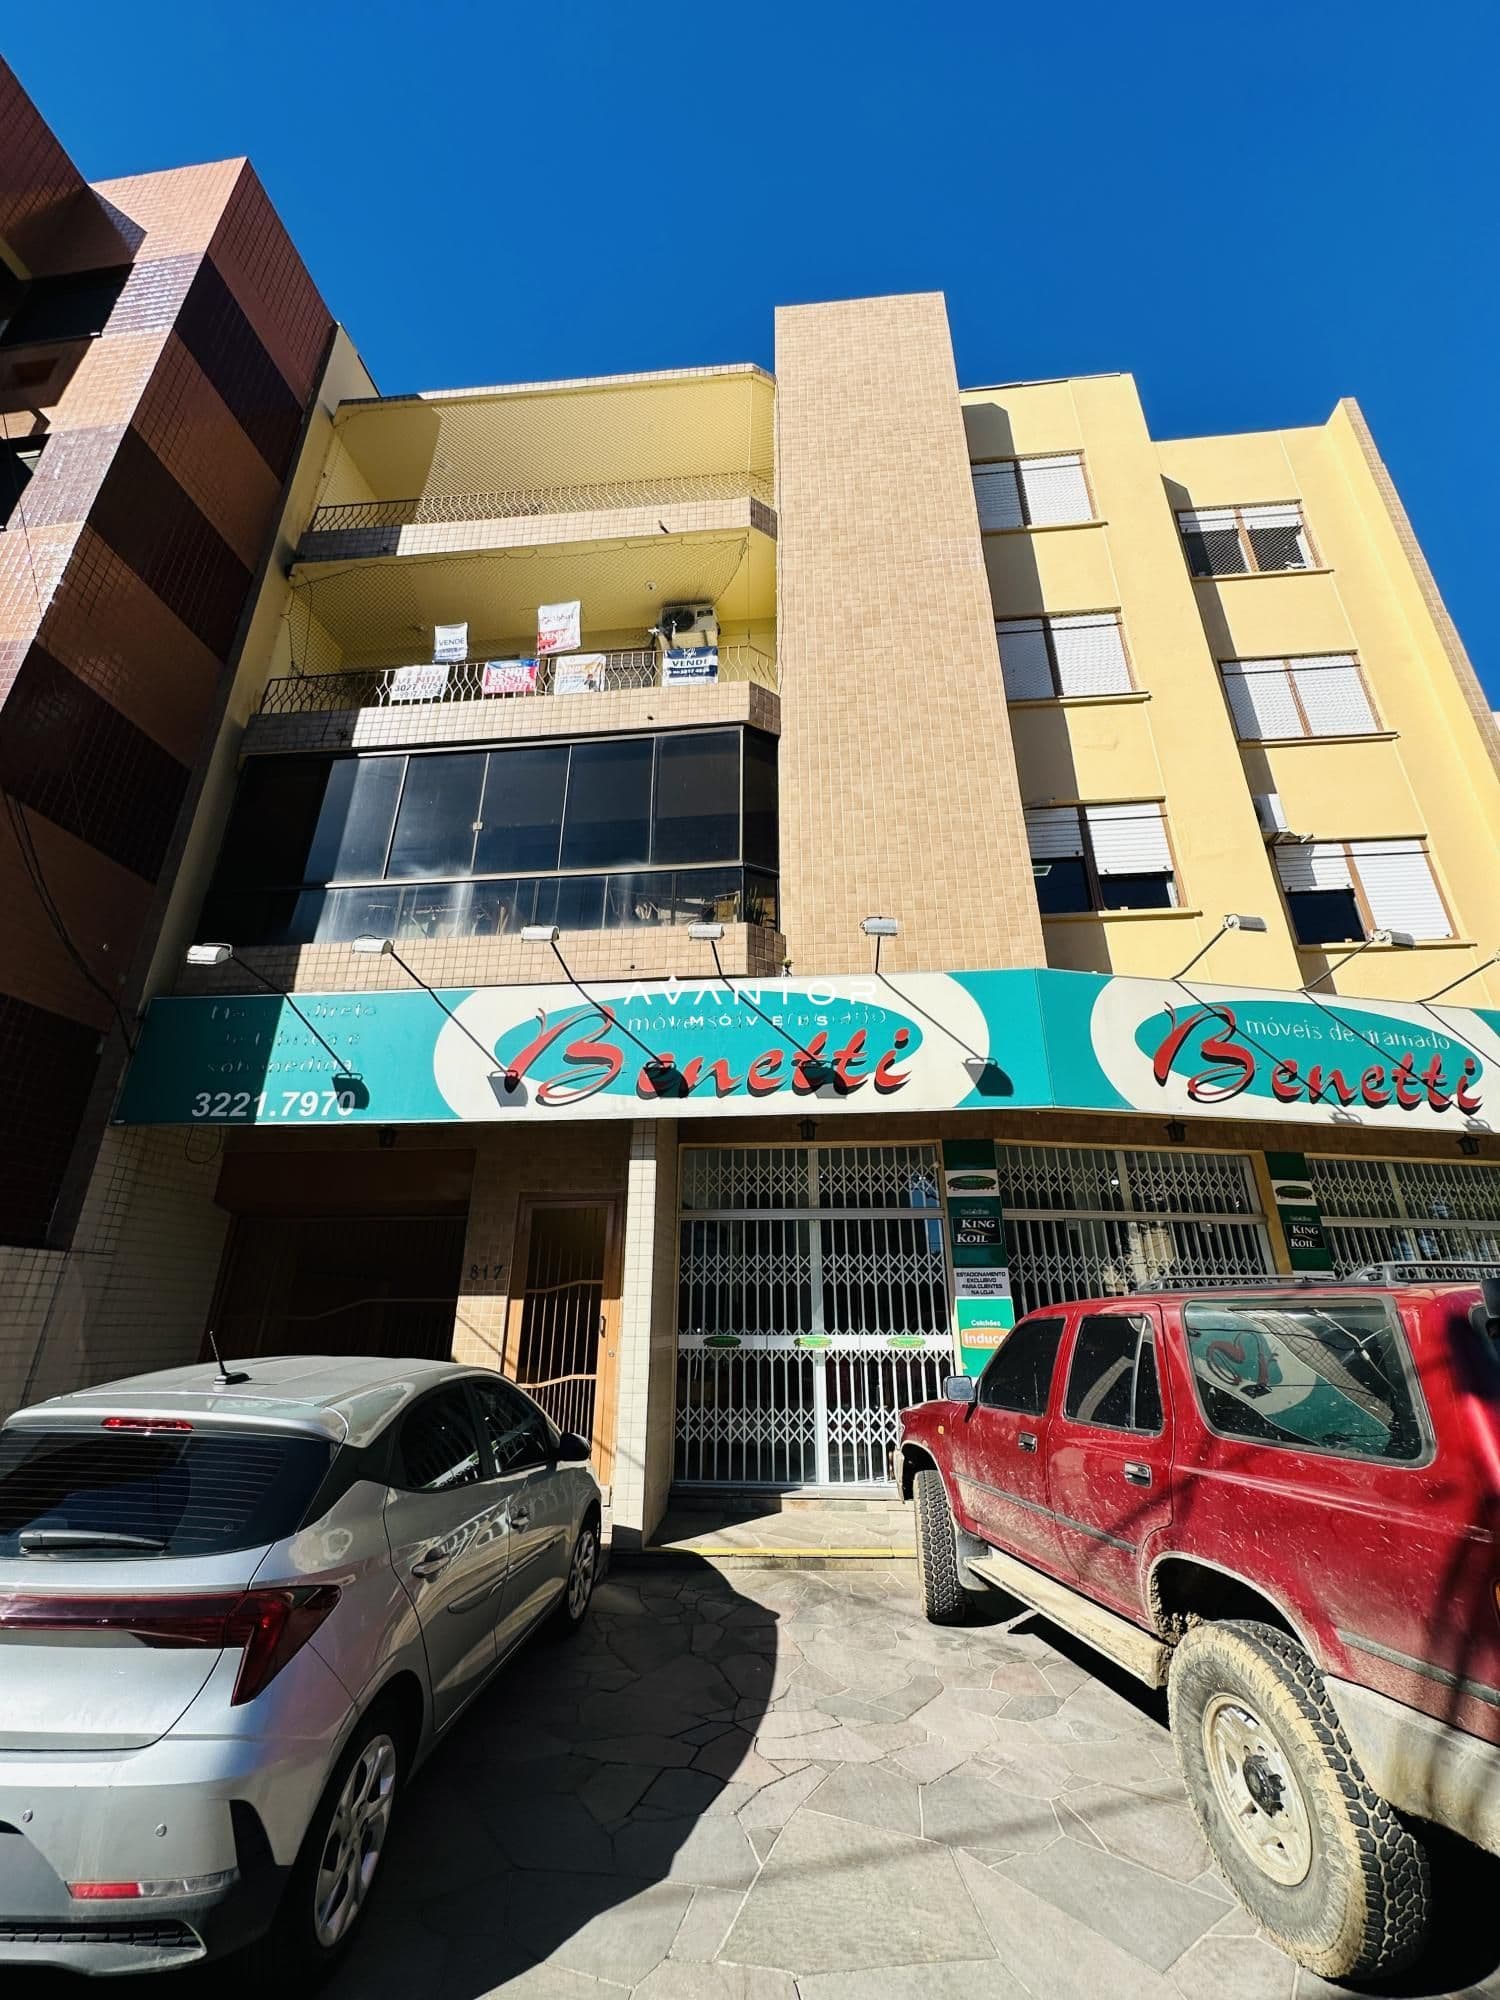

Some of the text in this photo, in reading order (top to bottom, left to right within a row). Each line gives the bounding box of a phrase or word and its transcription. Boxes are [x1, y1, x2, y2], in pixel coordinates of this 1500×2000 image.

[439, 637, 465, 646] VENDE
[1246, 1016, 1323, 1040] móveis
[1329, 1022, 1355, 1043] de
[505, 1004, 912, 1102] Benetti
[1153, 1001, 1483, 1114] Benetti
[191, 1089, 356, 1118] 3221.7970
[961, 1219, 996, 1229] KING
[1292, 1225, 1319, 1235] KING
[957, 1233, 989, 1243] KOIL
[1290, 1238, 1316, 1248] KOIL
[470, 1264, 503, 1280] 817
